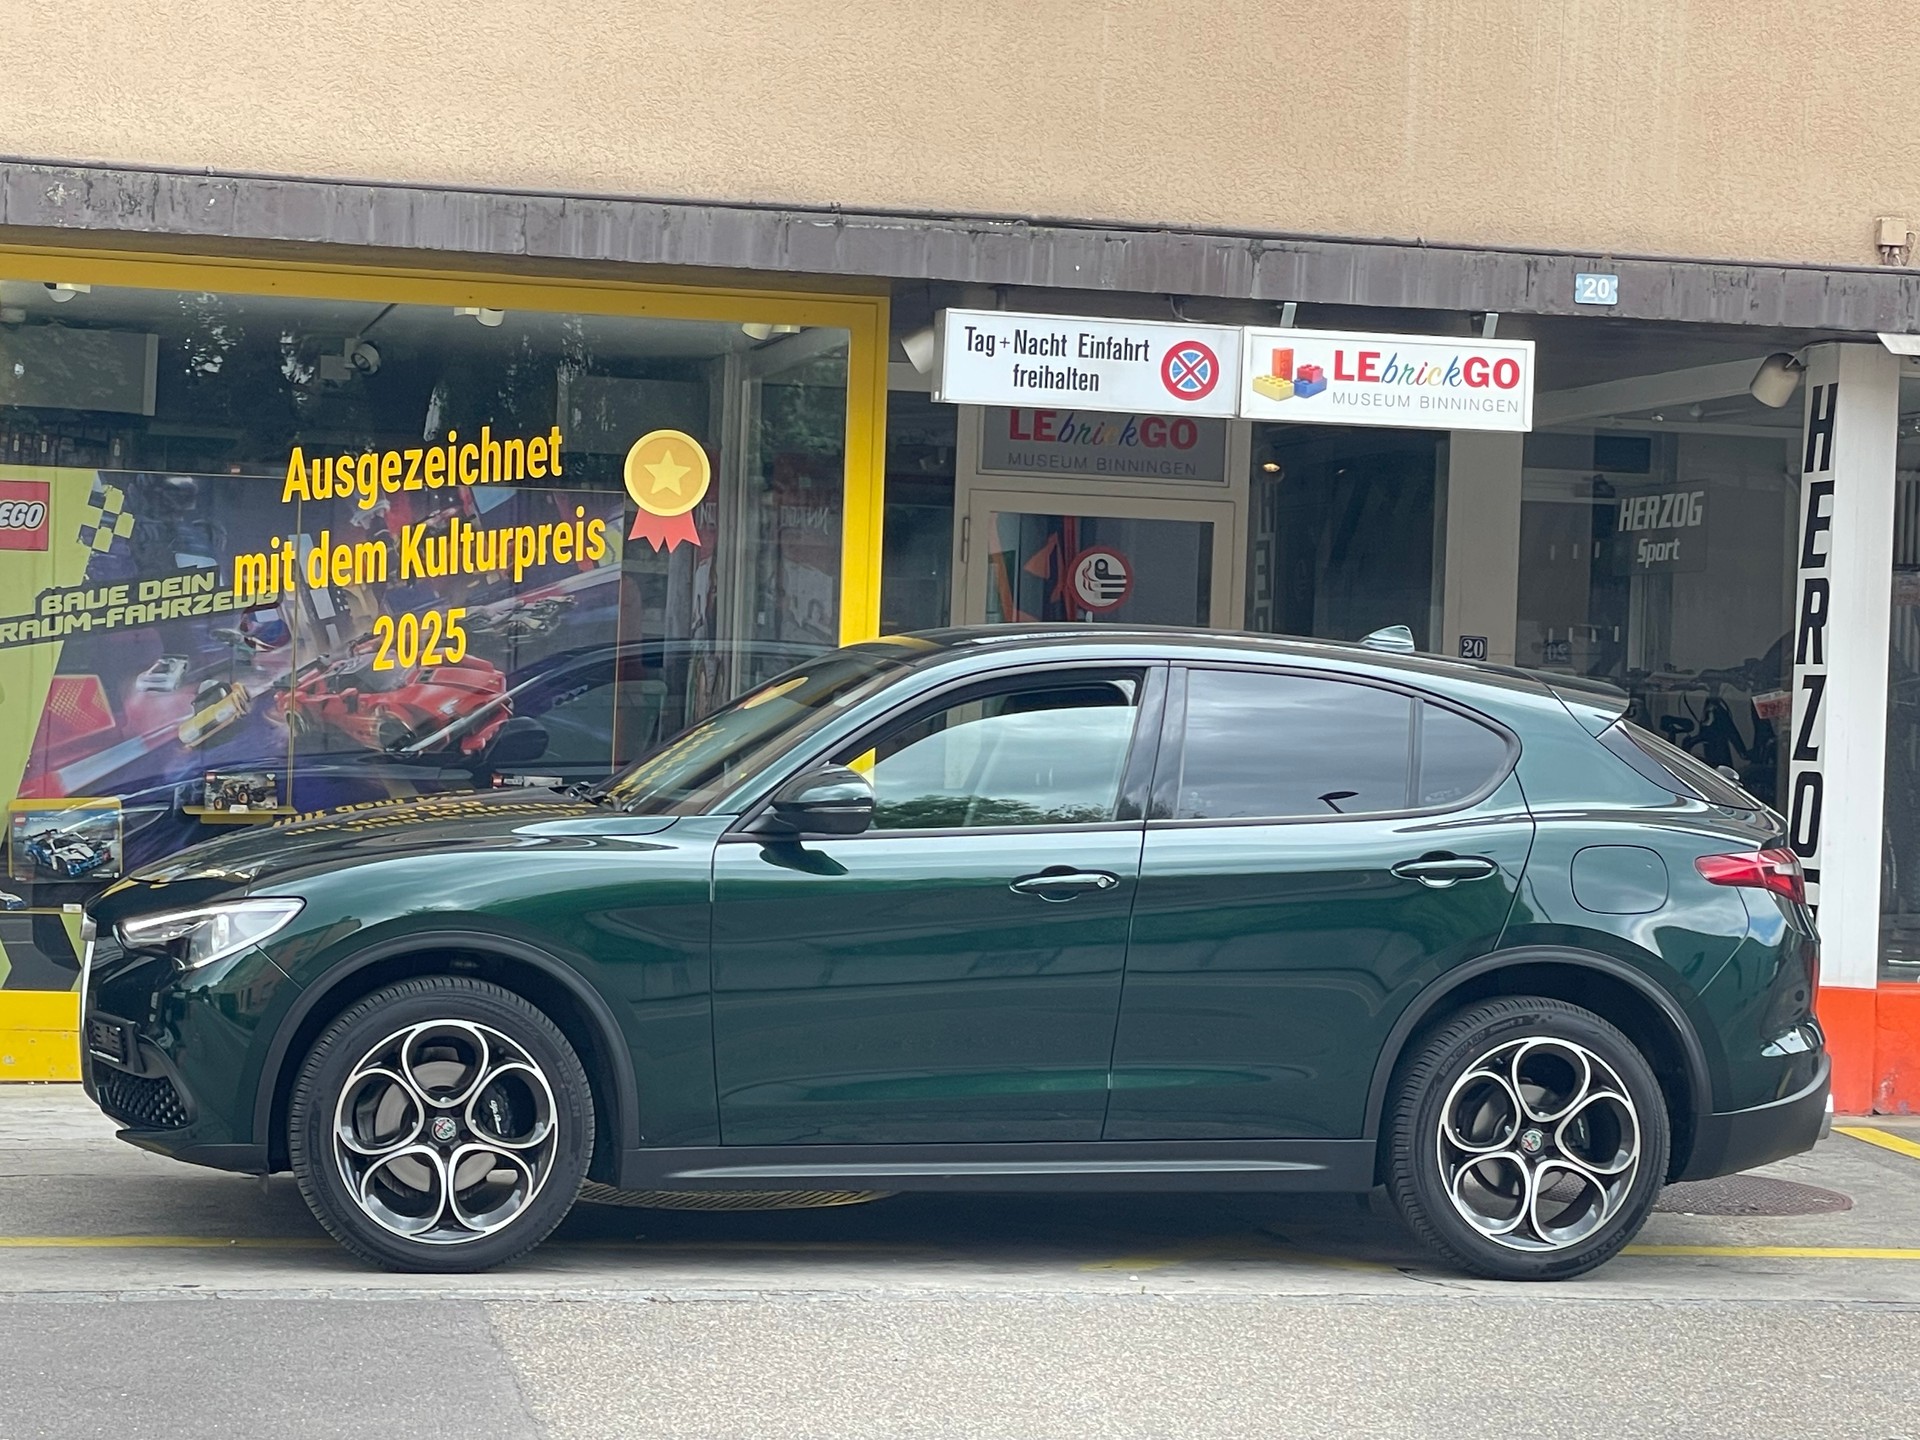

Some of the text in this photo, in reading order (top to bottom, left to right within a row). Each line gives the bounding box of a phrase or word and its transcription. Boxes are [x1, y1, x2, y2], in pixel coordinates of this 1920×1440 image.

[1583, 277, 1610, 299] 20
[1078, 332, 1150, 362] Einfahrt
[1013, 363, 1099, 392] freihalten
[1332, 391, 1519, 413] MUSEUM BINNINGEN
[281, 426, 563, 509] Ausgezeichnet
[1008, 452, 1197, 476] MUSEUM BINNINGEN
[0, 500, 46, 529] EGO
[1618, 490, 1705, 532] HERZOG
[233, 505, 607, 598] mit dem Kulturpreis
[1637, 538, 1680, 568] Sport
[41, 571, 215, 616] BAUE DEIN
[372, 607, 468, 671] 2025
[1462, 639, 1485, 659] 20
[1790, 383, 1838, 921] HERZO
